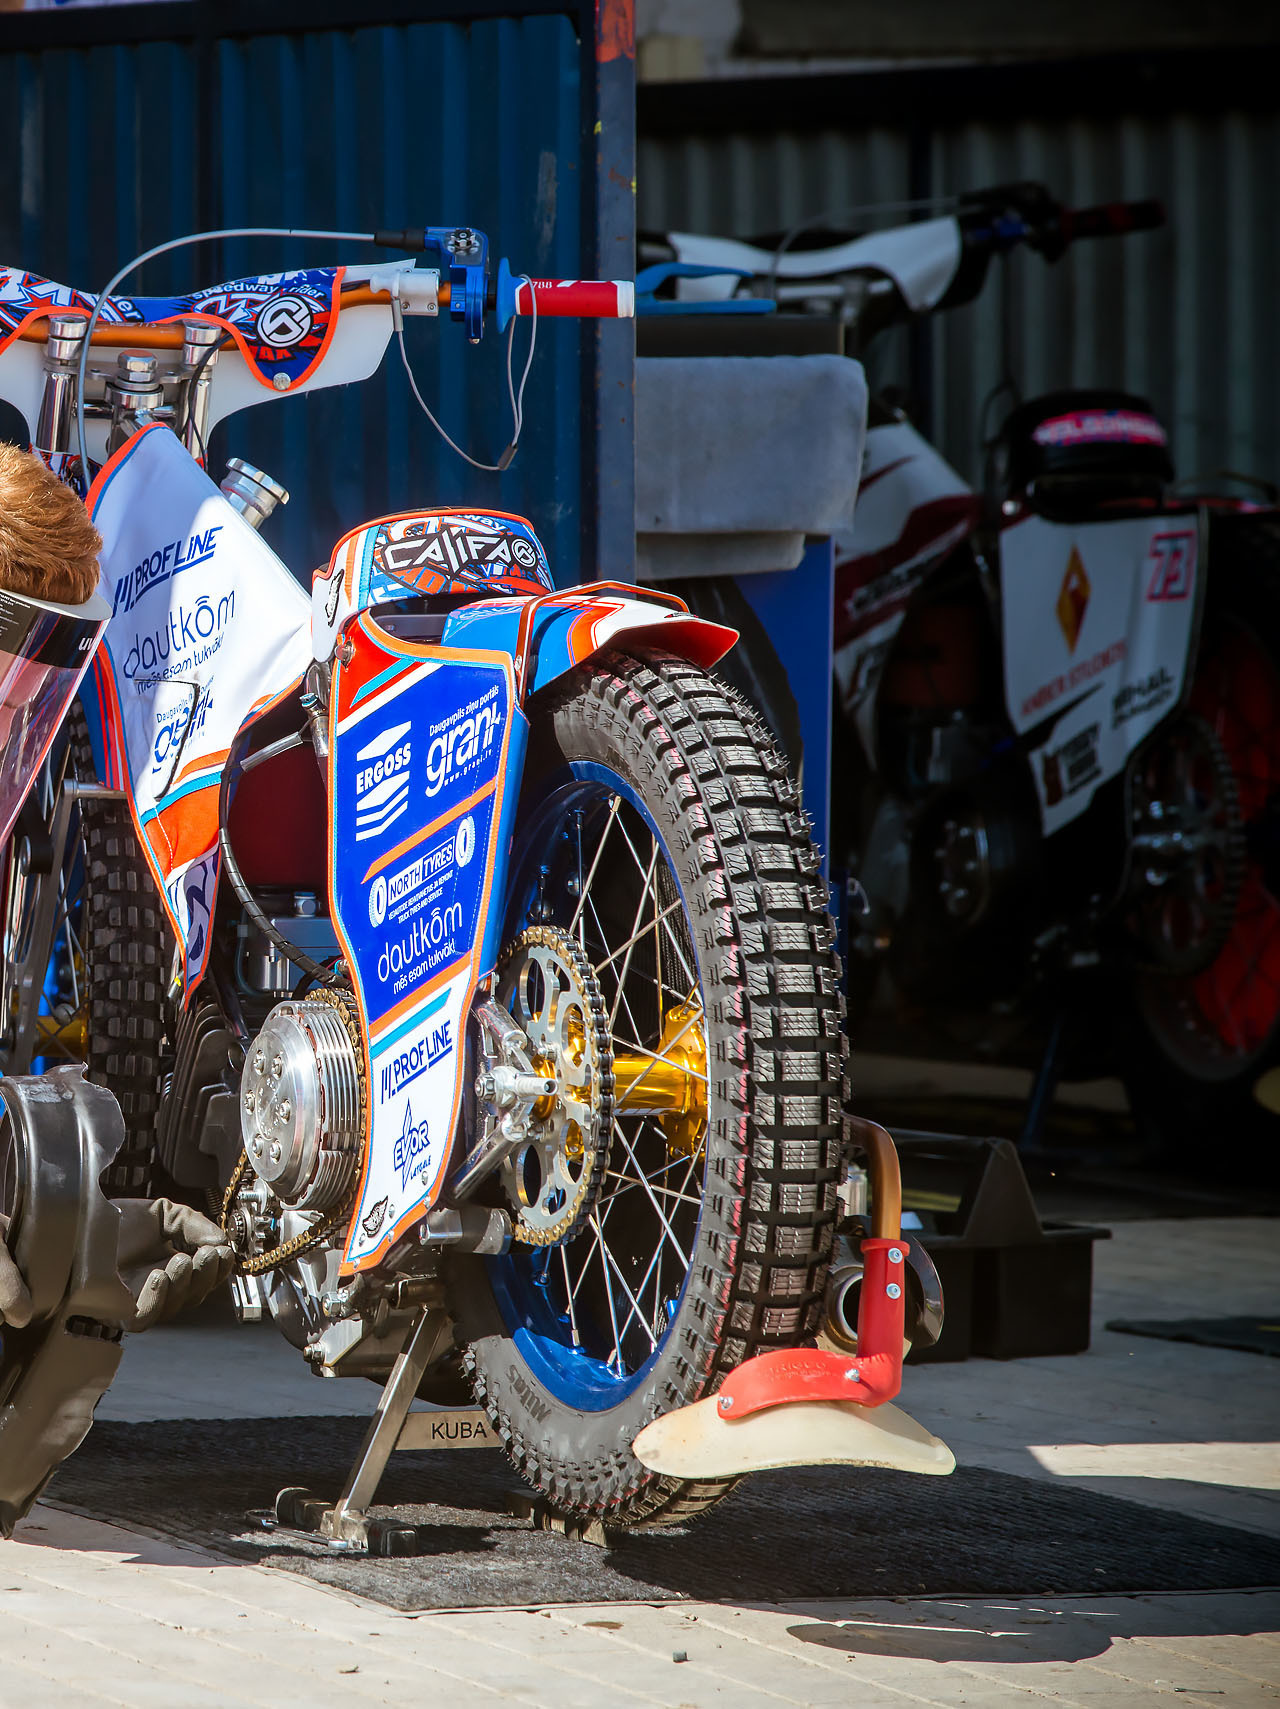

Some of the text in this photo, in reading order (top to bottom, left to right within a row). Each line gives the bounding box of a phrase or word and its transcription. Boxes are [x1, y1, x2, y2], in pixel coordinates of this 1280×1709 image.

[289, 283, 326, 299] rider
[429, 707, 465, 736] Daugavpils
[356, 742, 411, 795] ERGOSS
[390, 843, 453, 901] NORTH TYRES
[431, 1421, 488, 1440] KUBA
